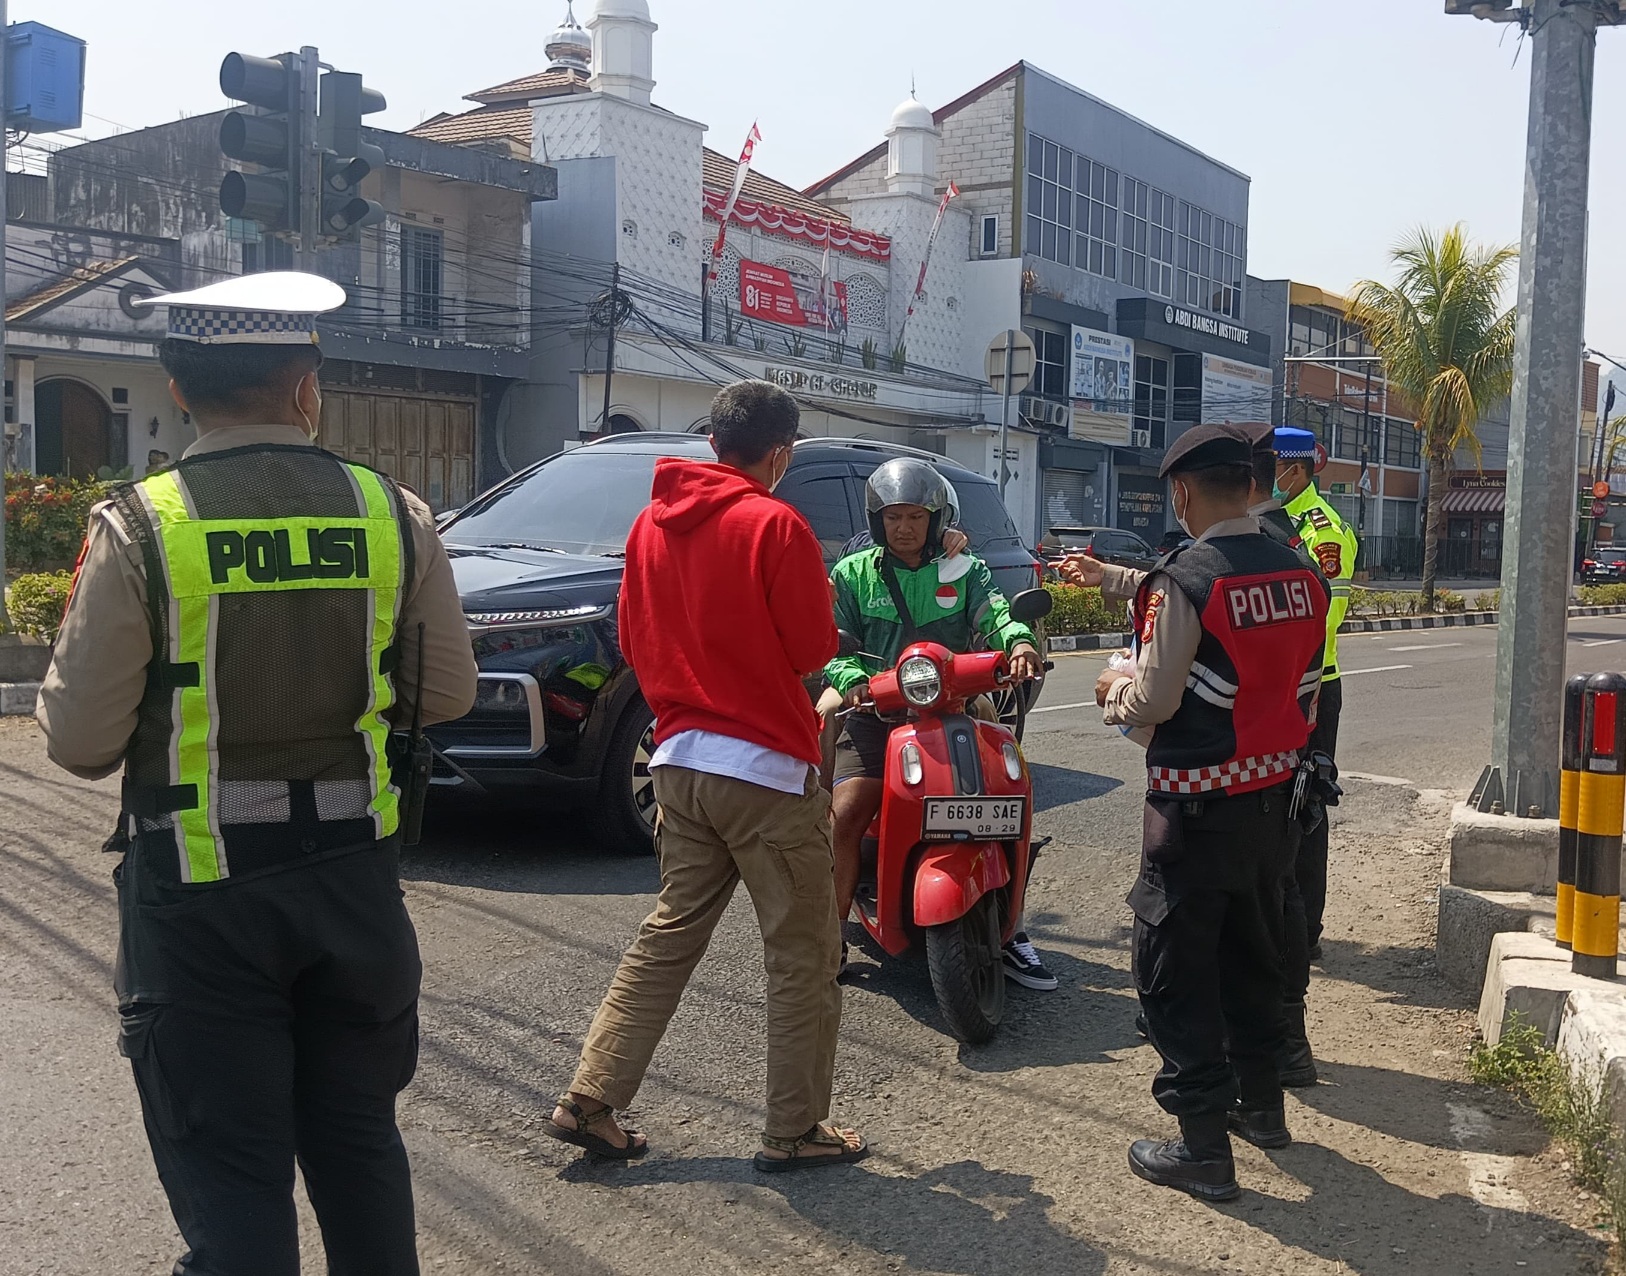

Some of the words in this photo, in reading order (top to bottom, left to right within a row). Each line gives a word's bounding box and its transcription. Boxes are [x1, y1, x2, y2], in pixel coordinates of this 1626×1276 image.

[1175, 309, 1191, 328] ABDI
[1192, 314, 1217, 336] BANGSA
[1218, 323, 1249, 345] INSTITUTE
[206, 527, 370, 584] POLISI
[1230, 579, 1313, 627] POLISI
[930, 805, 939, 819] F
[947, 805, 983, 820] 6638
[993, 805, 1018, 819] SAE
